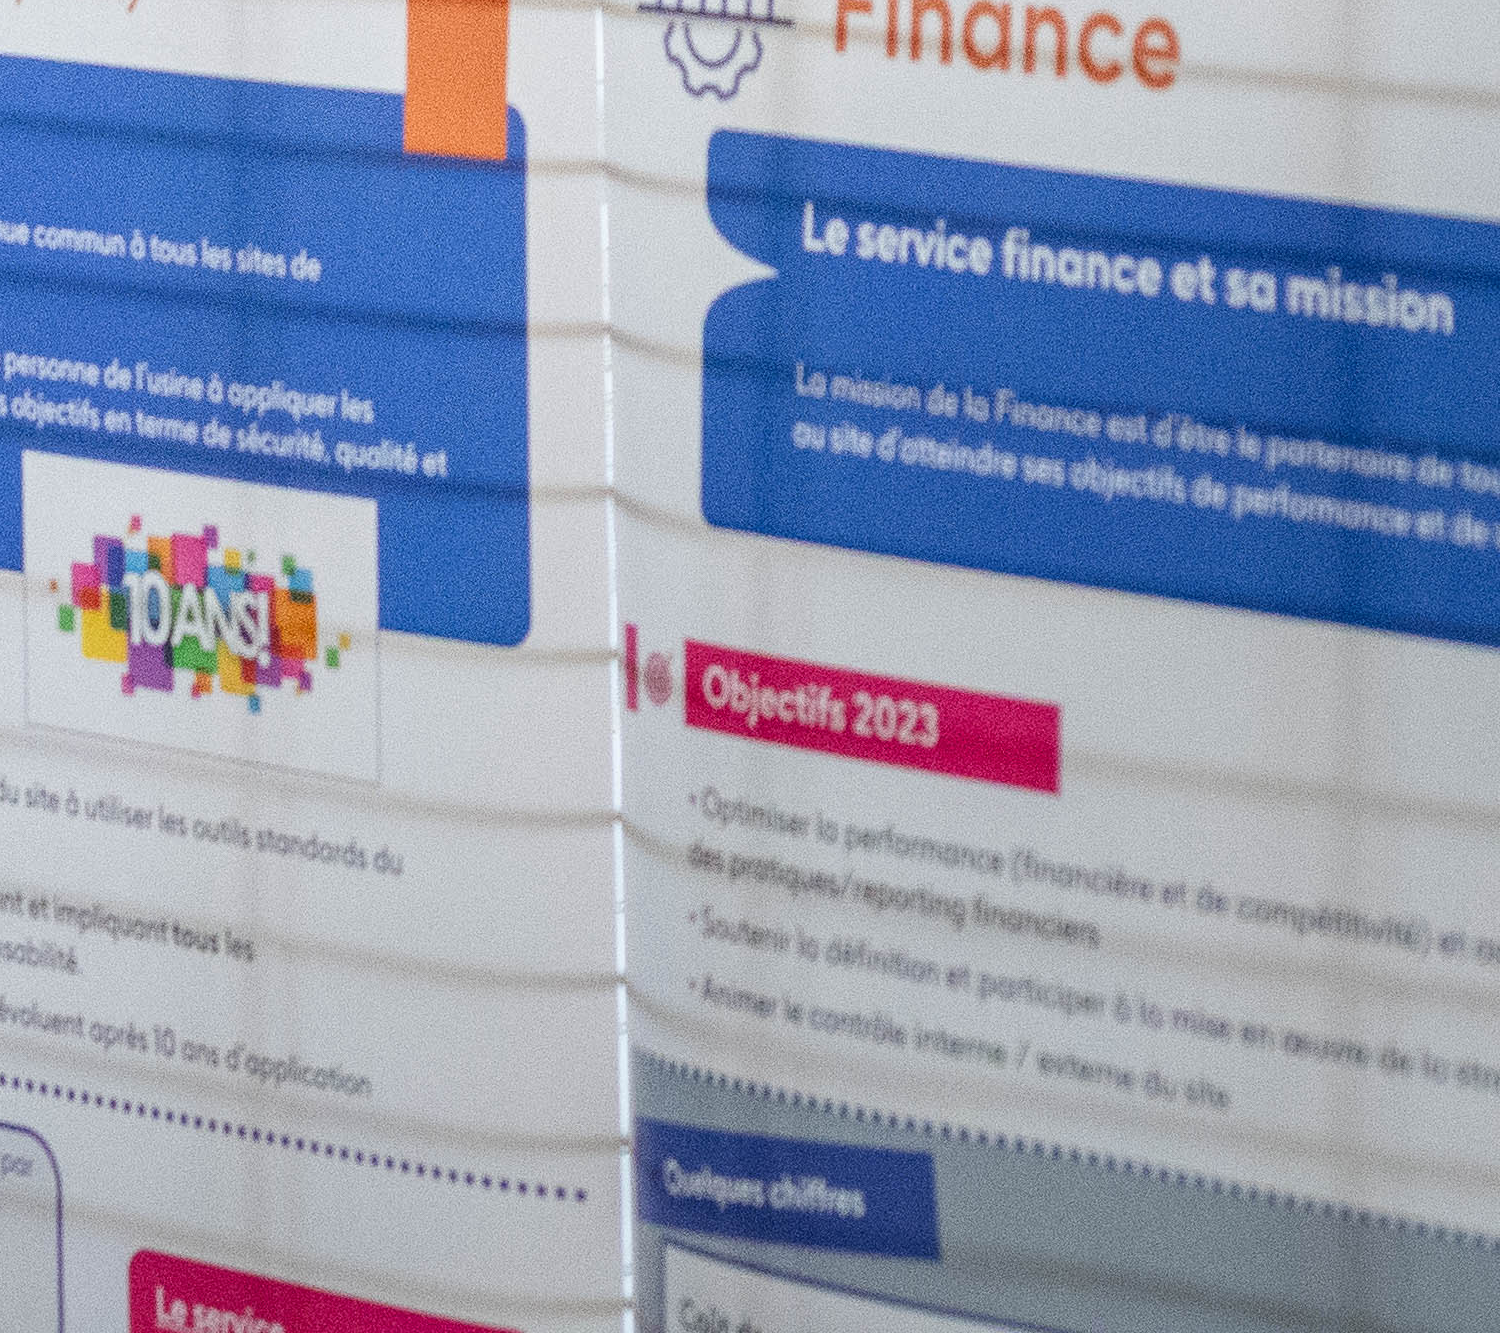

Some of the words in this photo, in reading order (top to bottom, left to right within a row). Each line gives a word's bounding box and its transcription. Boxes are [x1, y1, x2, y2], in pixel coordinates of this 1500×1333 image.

[32, 224, 127, 257] commun
[129, 228, 147, 261] à
[149, 235, 198, 267] tous
[200, 237, 233, 273] les
[236, 246, 287, 278] sites
[289, 248, 323, 283] de
[802, 203, 850, 257] Le
[856, 220, 994, 277] service
[1001, 227, 1163, 298] finance
[1169, 256, 1216, 305] et
[1225, 267, 1277, 313] sa
[1286, 268, 1454, 335] mission
[702, 663, 846, 732] Objectifs
[852, 689, 939, 748] 2023
[664, 1159, 767, 1208] Quelques
[765, 1175, 866, 1219] chiffres
